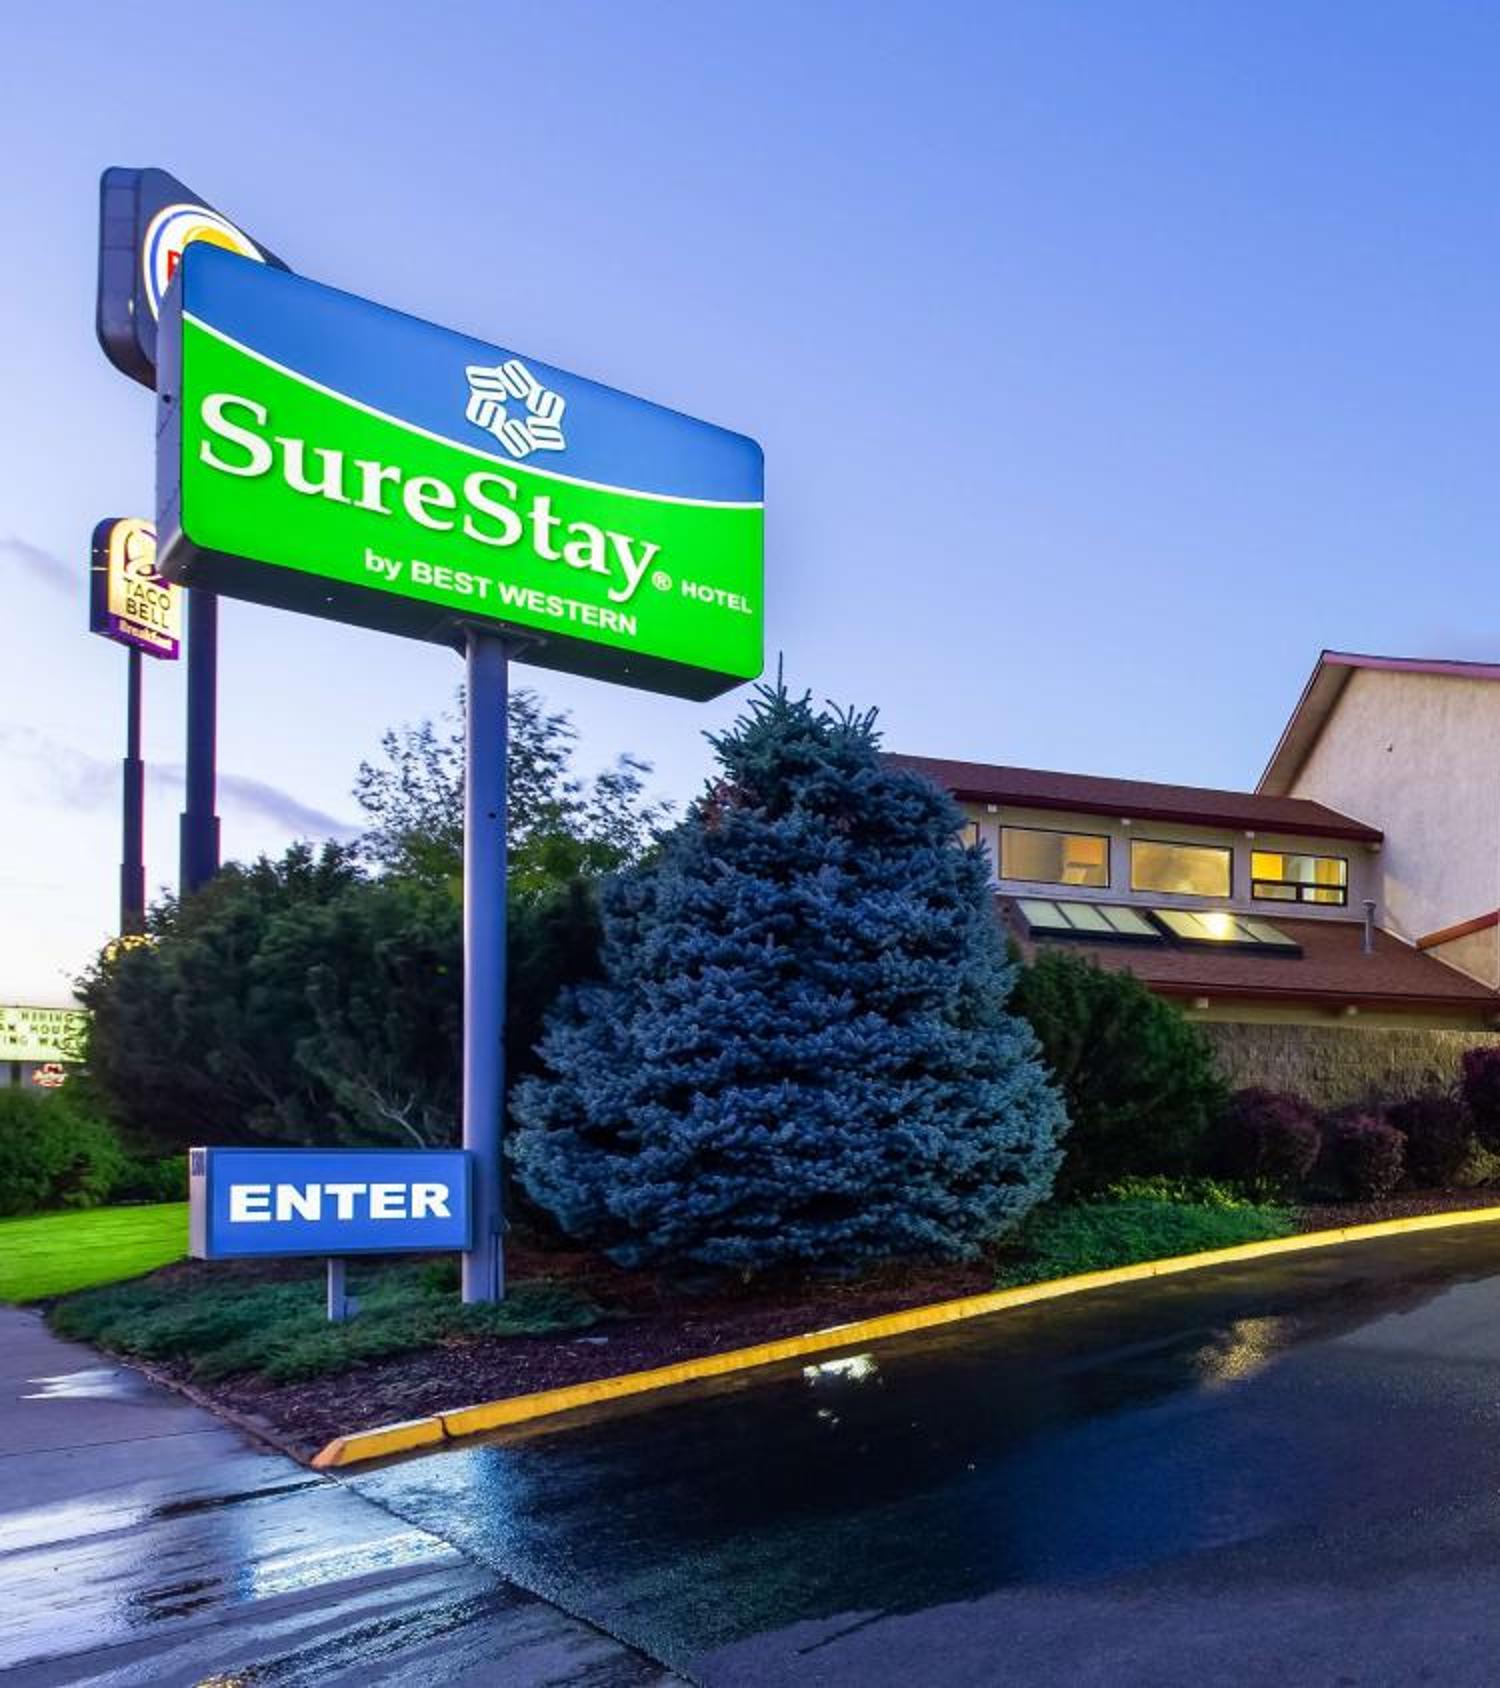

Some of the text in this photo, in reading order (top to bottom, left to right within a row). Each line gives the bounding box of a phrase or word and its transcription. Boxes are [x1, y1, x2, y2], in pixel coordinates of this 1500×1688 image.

[124, 577, 171, 610] TACO
[364, 548, 637, 636] by BEST WESTERN
[681, 579, 753, 614] HOTEL
[126, 597, 169, 628] BELL
[229, 1183, 451, 1222] ENTER
